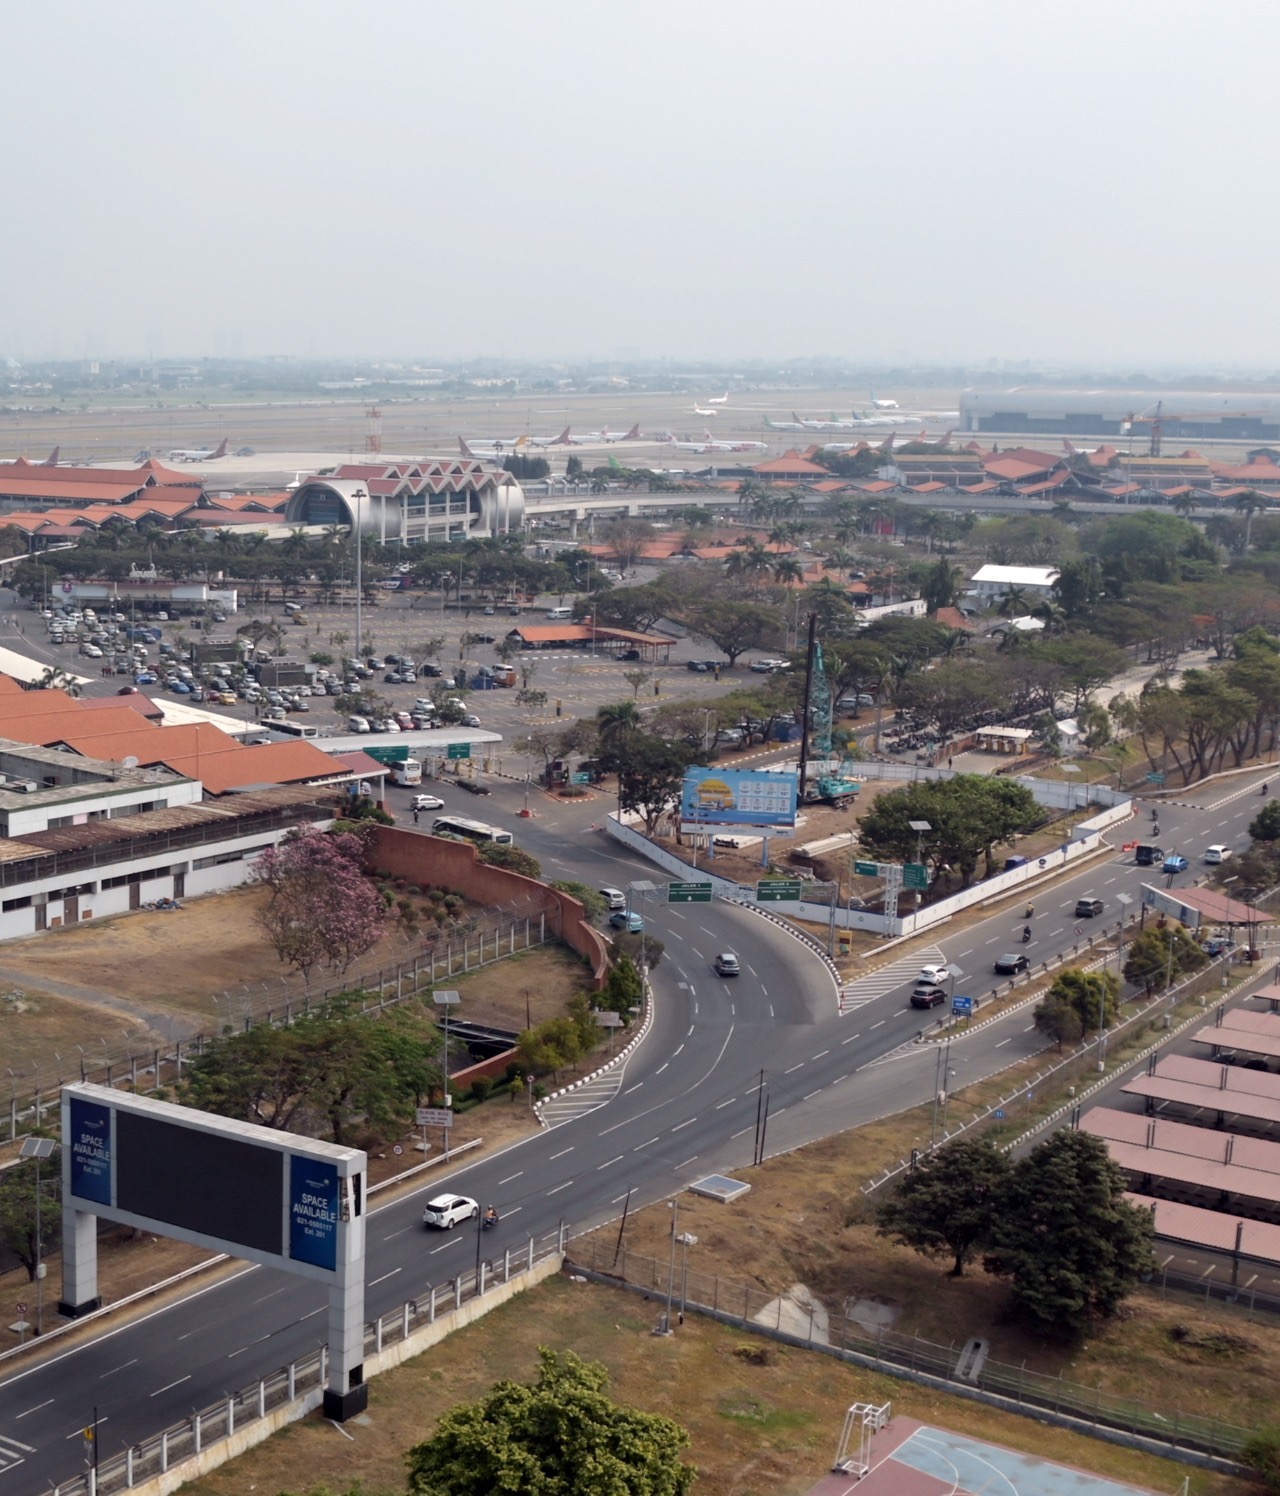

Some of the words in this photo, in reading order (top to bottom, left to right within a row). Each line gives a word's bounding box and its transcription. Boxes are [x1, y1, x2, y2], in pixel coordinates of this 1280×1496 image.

[81, 1134, 104, 1148] SPACE
[73, 1143, 110, 1162] AVAILABLE
[301, 1193, 329, 1209] SPACE
[293, 1203, 337, 1223] AVAILABLE
[304, 1227, 315, 1236] Ext.
[315, 1230, 326, 1239] 201
